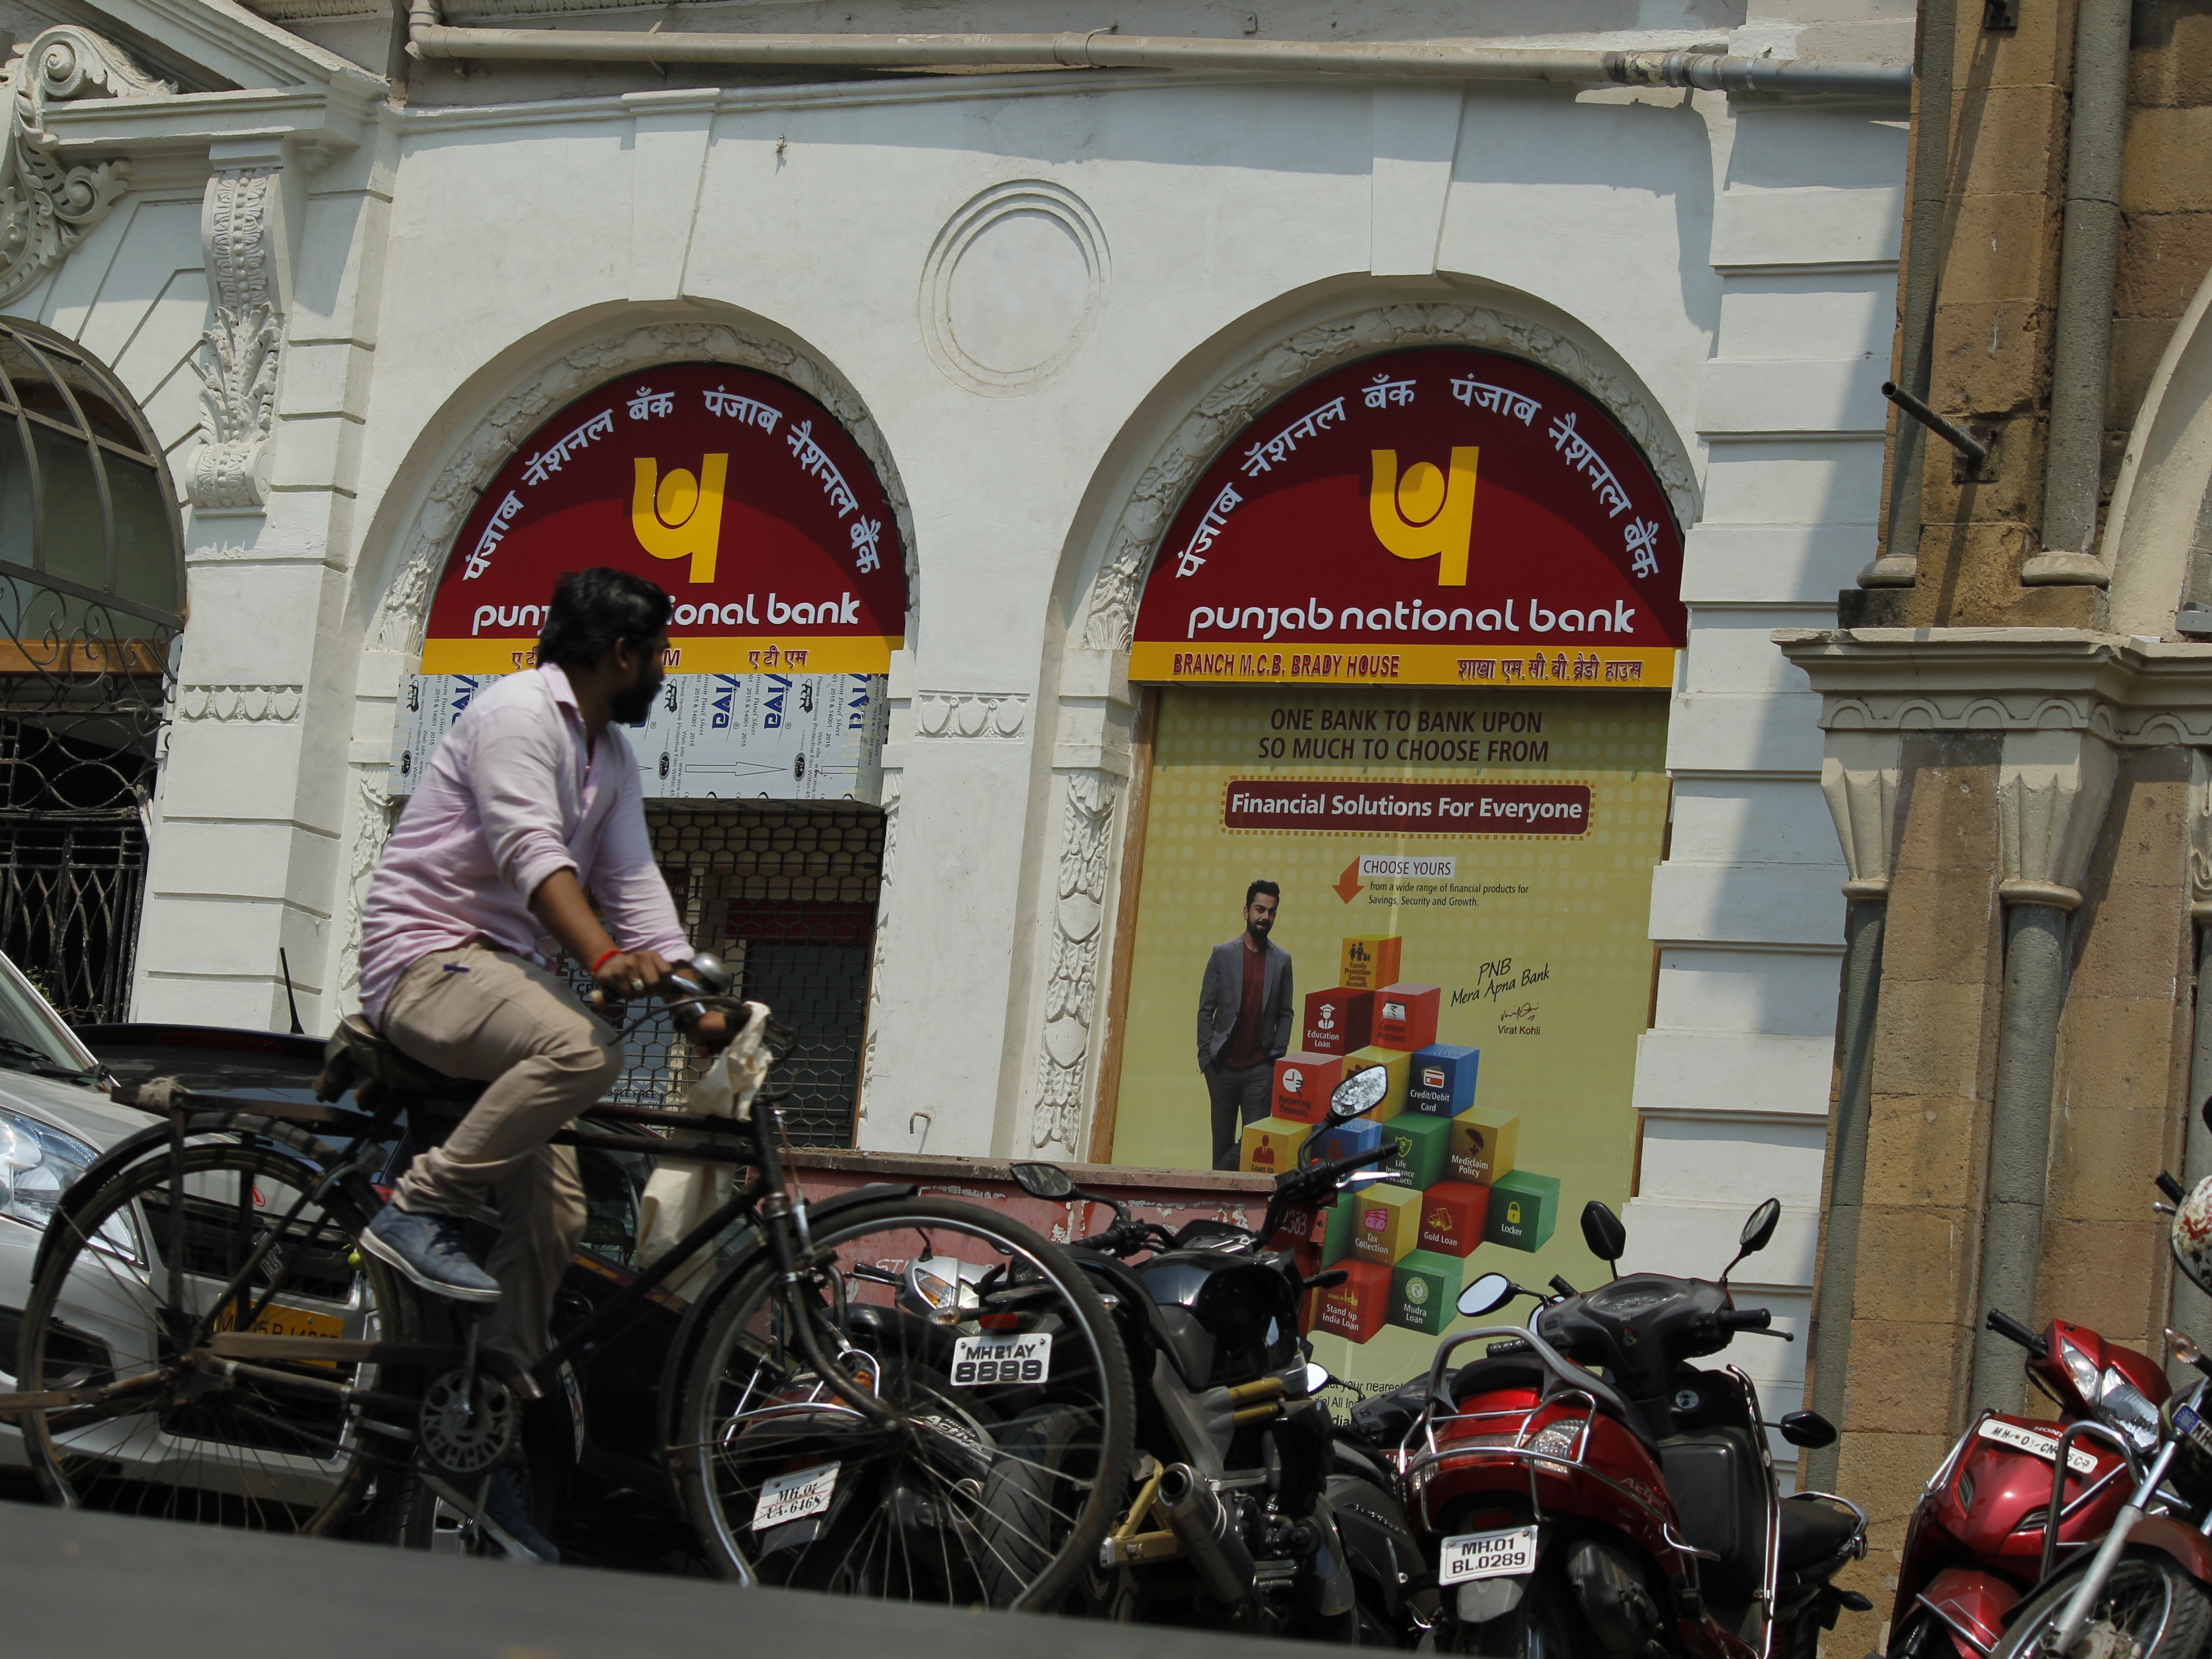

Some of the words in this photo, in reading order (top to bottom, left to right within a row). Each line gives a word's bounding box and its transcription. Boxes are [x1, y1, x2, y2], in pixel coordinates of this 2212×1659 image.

[703, 385, 782, 435] पंजाब
[787, 421, 858, 518] नैशनल
[851, 515, 881, 573] बैंक
[1176, 483, 1243, 578] पंजाब
[1241, 397, 1346, 476] नॅशनल
[1362, 374, 1416, 409] बँक
[1450, 373, 1541, 427] पंजाब
[1549, 413, 1632, 518] नैशनल
[1625, 517, 1658, 578] बैंक
[463, 491, 524, 580] पंजाब
[521, 409, 613, 485] नॅशनल
[627, 386, 674, 421] बँक
[472, 604, 551, 636] punj
[667, 594, 759, 625] ional
[767, 592, 860, 624] bank
[1188, 598, 1333, 639] punjab
[1340, 600, 1519, 632] national
[1529, 599, 1635, 633] bank
[1173, 653, 1235, 674] BRANCH
[1240, 653, 1285, 675] M.C.B.
[1291, 654, 1343, 676] BRADY
[1346, 655, 1400, 676] HOUSE
[1457, 659, 1496, 680] शाखा
[1605, 660, 1643, 680] हाउस
[1271, 709, 1313, 730] ONE
[1321, 709, 1378, 731] BANK
[1385, 710, 1410, 731] TO
[1418, 711, 1476, 733] BANK
[1482, 711, 1542, 733] UPON
[1258, 737, 1285, 758] SO
[1293, 738, 1354, 759] MUCH
[1363, 739, 1389, 759] TO
[1396, 739, 1480, 761] CHOOSE
[1488, 740, 1549, 762] FROM
[1232, 793, 1325, 815] Financial
[1331, 795, 1432, 817] Solutions
[1439, 797, 1473, 817] For
[1479, 798, 1583, 823] Everyone
[1364, 861, 1409, 874] CHOOSE
[1414, 862, 1451, 875] YOURS
[1370, 882, 1387, 891] from
[1396, 883, 1414, 892] wide
[1416, 886, 1437, 894] range
[1440, 883, 1447, 892] of
[1449, 884, 1480, 893] financial
[1483, 884, 1515, 895] products
[1518, 884, 1529, 893] for
[1369, 896, 1398, 906] Savings,
[1401, 897, 1430, 907] Security
[1432, 897, 1446, 906] and
[1449, 897, 1479, 906] Growth.
[1345, 968, 1371, 976] Protection
[1348, 974, 1366, 983] Saving
[1478, 958, 1512, 985] PNB
[1451, 990, 1479, 1007] Mera
[1484, 979, 1515, 1002] Apna
[1521, 963, 1550, 986] Bank
[1379, 1022, 1405, 1033] Current
[1498, 1026, 1517, 1035] Virat
[1519, 1025, 1540, 1035] Kohli
[1308, 1030, 1339, 1041] Education
[1377, 1031, 1405, 1043] Account
[1315, 1040, 1330, 1048] Loan
[1279, 1094, 1311, 1110] Recurring
[1410, 1090, 1450, 1102] Credit/Debit
[1279, 1105, 1309, 1117] Deposits
[1421, 1103, 1436, 1112] Card
[1251, 1164, 1265, 1172] Loan
[1452, 1155, 1488, 1169] Mediclaim
[1386, 1166, 1415, 1178] Insurance
[1459, 1166, 1480, 1178] Policy
[1502, 1224, 1523, 1236] Locker
[1367, 1233, 1378, 1243] Tax
[1424, 1232, 1439, 1242] Gold
[1441, 1236, 1457, 1246] Loan
[1355, 1238, 1388, 1254] Collection
[1326, 1304, 1346, 1316] Stand
[1348, 1310, 1357, 1321] up
[1404, 1303, 1427, 1317] Mudra
[1322, 1313, 1340, 1324] India
[1342, 1318, 1358, 1331] Loan
[1406, 1313, 1423, 1324] Loan
[955, 1359, 1042, 1382] 8899
[1331, 1397, 1343, 1407] All
[1462, 1538, 1514, 1556] MH.01
[1453, 1552, 1525, 1574] BL.0289
